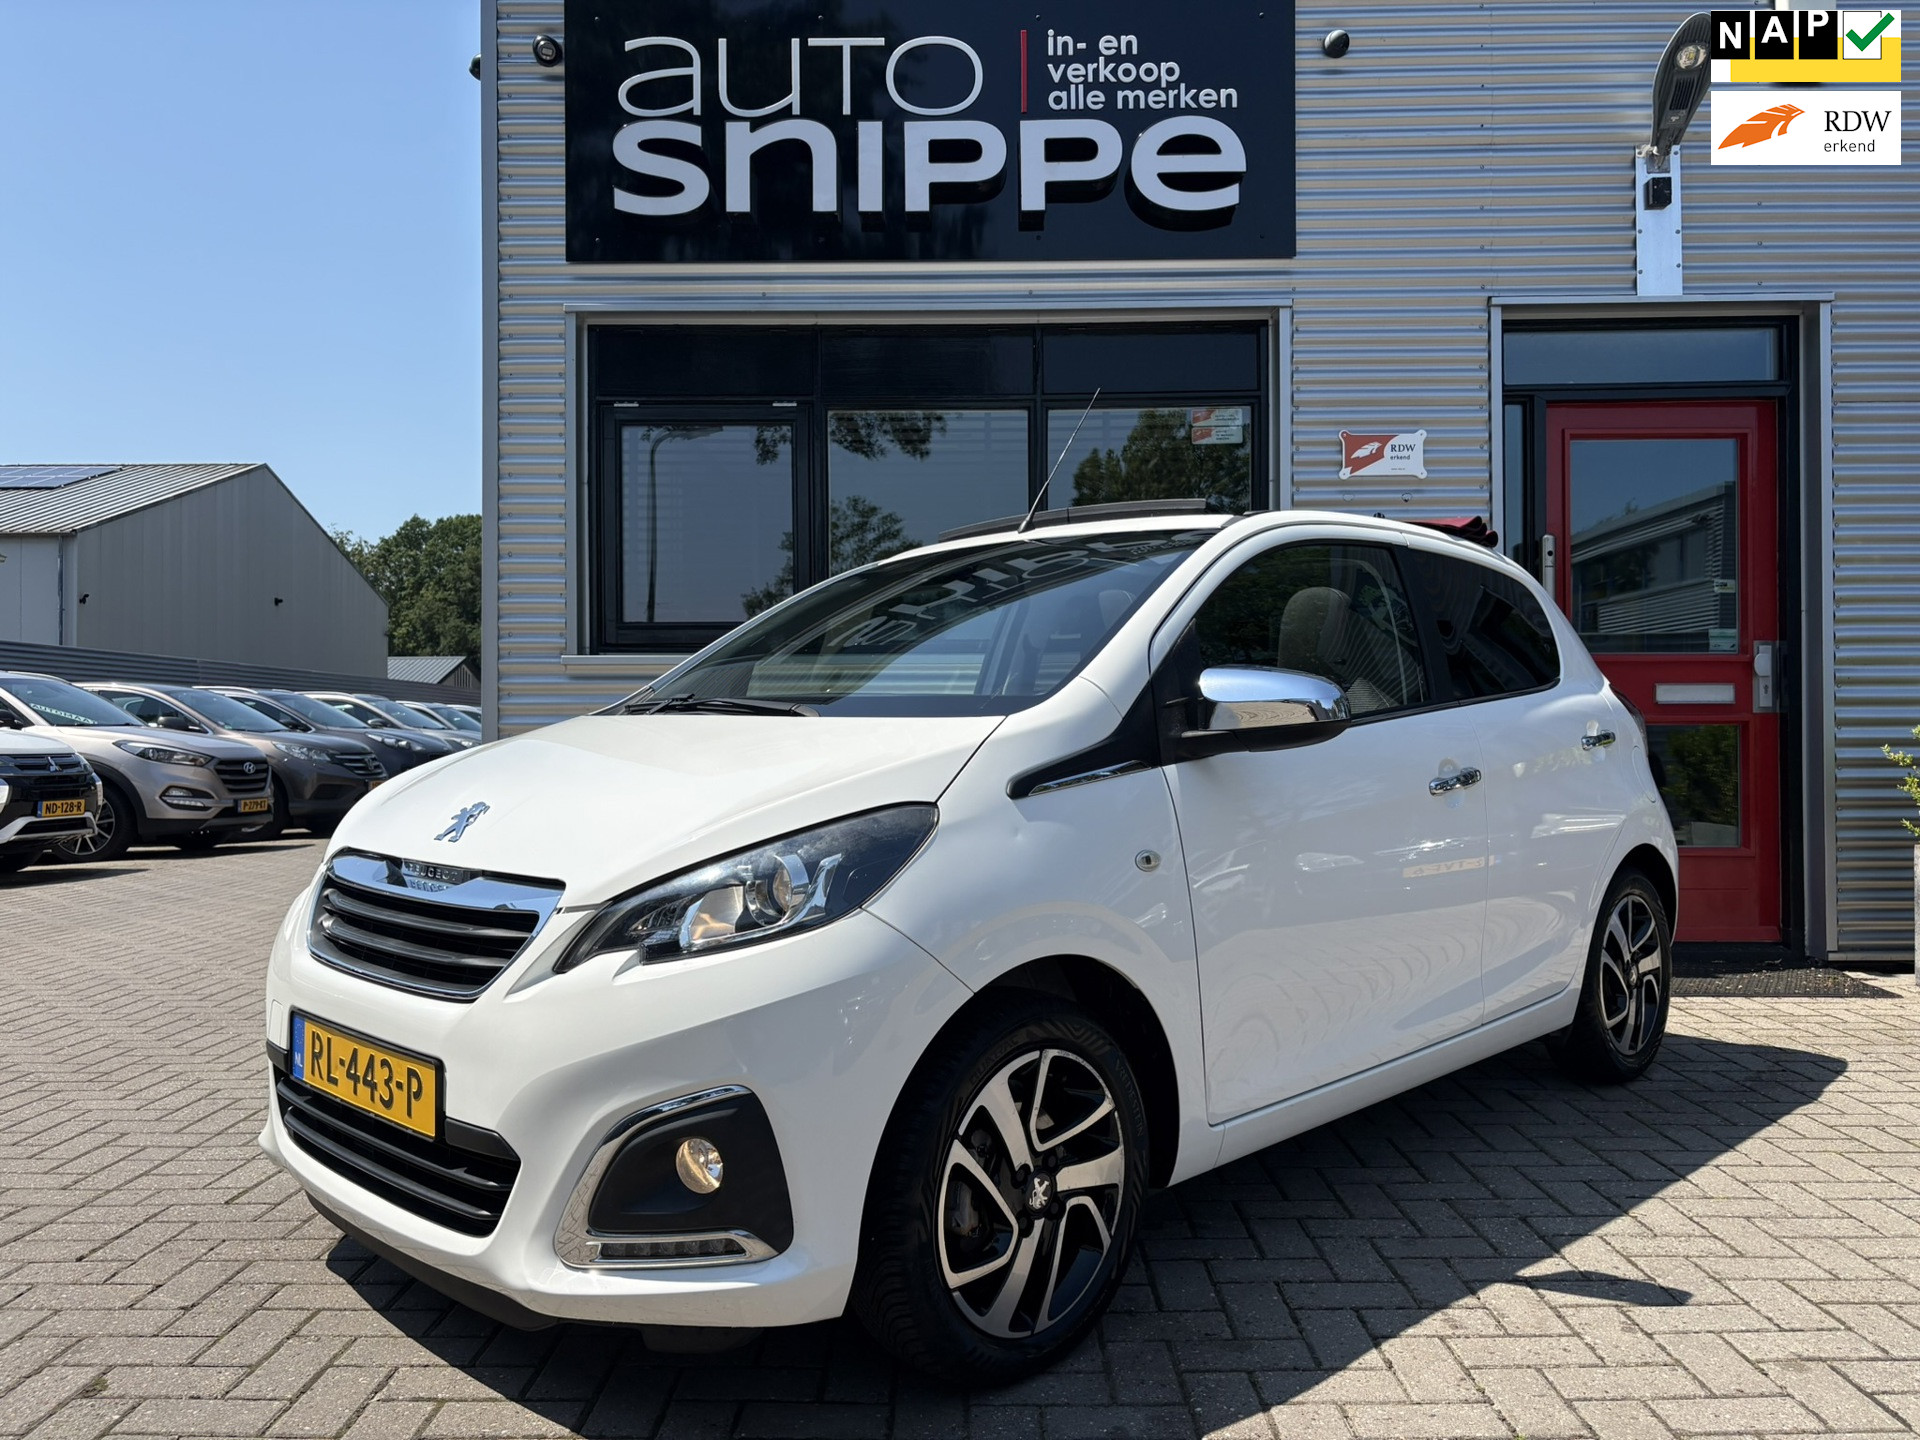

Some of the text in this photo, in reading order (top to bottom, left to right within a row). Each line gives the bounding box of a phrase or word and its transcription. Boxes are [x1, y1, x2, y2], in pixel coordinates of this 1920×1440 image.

[1048, 29, 1138, 56] in- en
[1047, 56, 1181, 88] verkoop
[1048, 83, 1238, 110] alle merken
[1390, 444, 1416, 452] RDW
[45, 801, 83, 814] ND-128-R
[310, 1029, 423, 1119] RL-443-P
